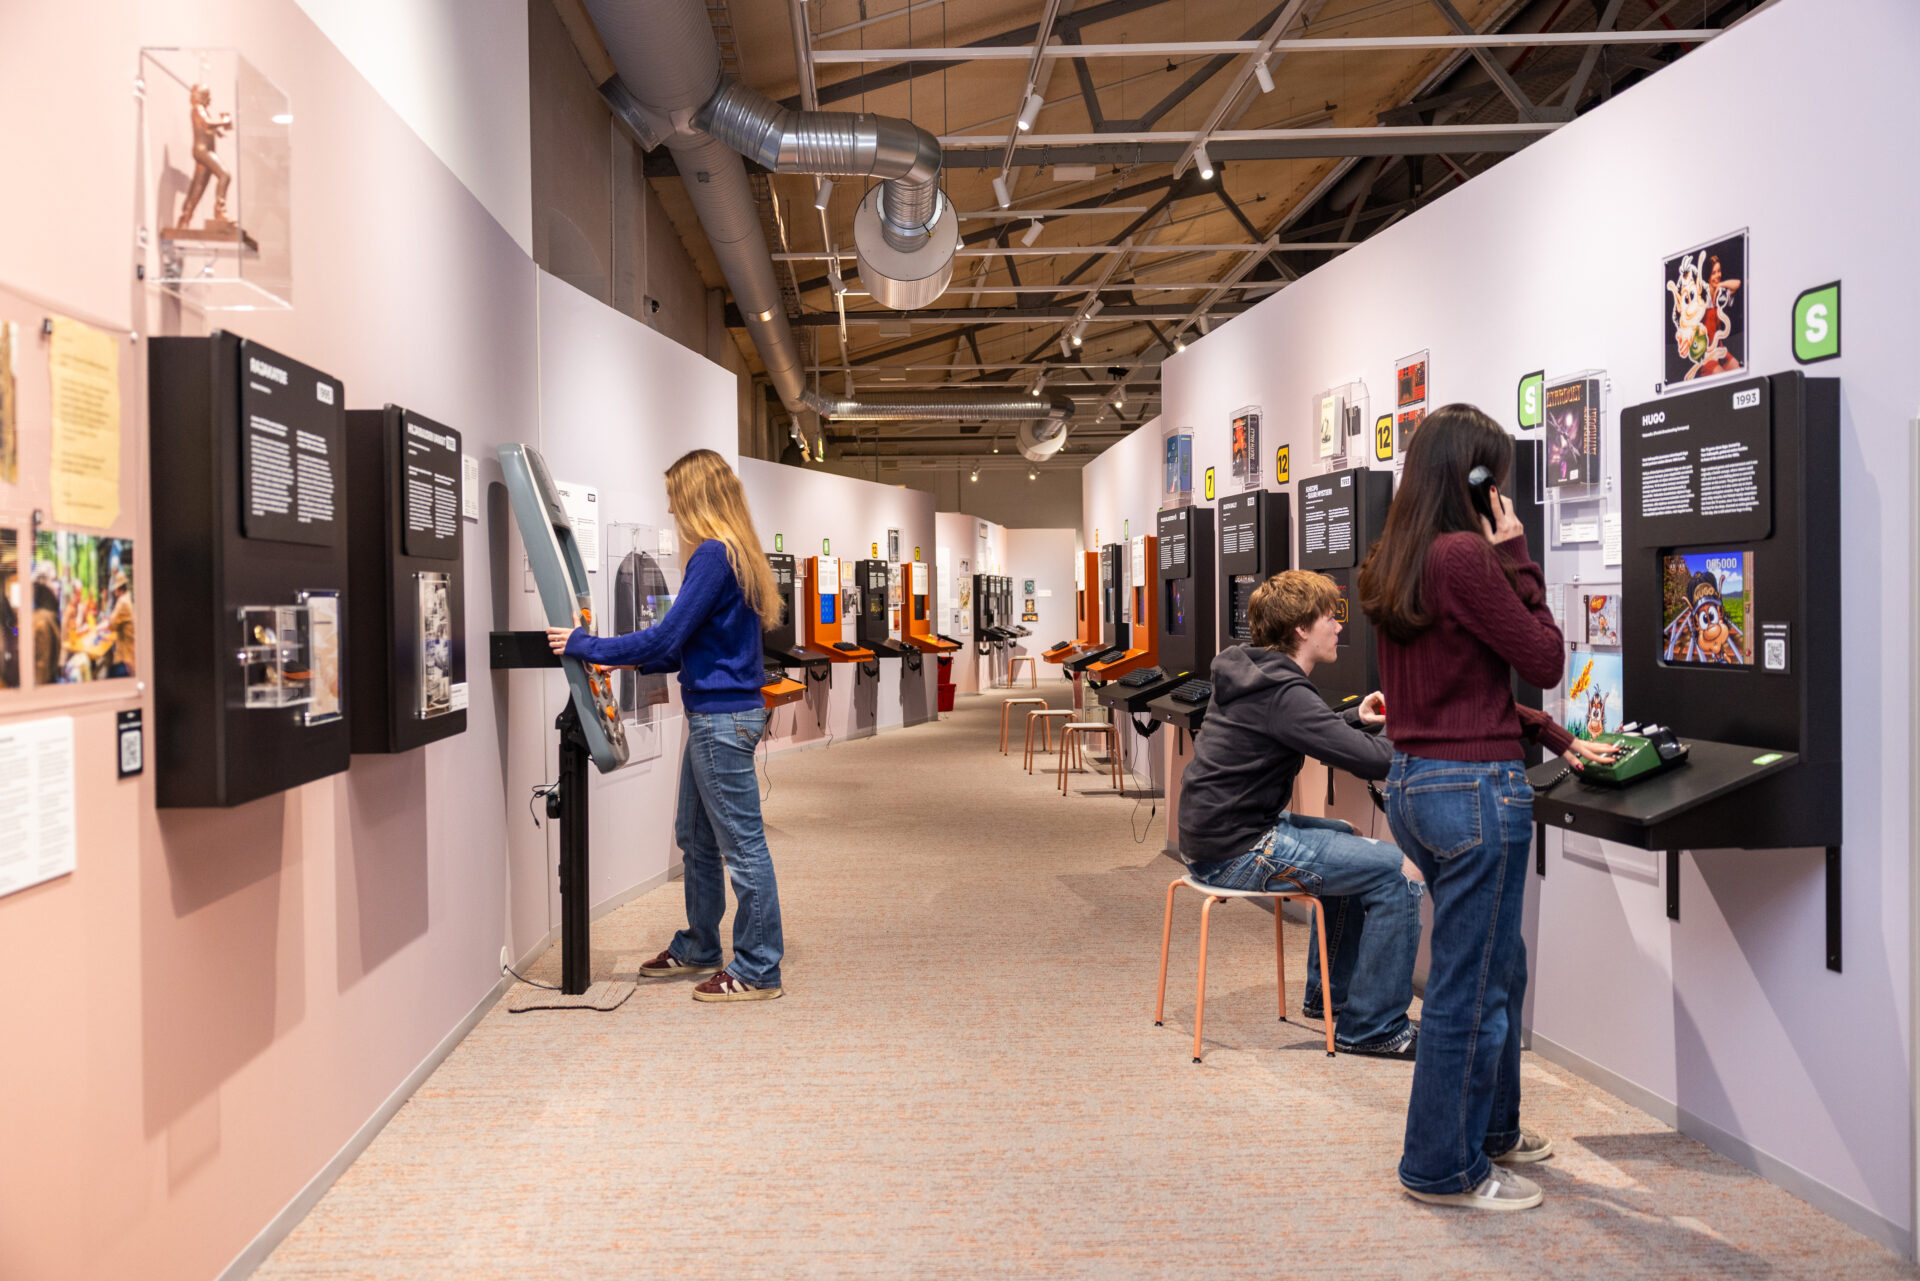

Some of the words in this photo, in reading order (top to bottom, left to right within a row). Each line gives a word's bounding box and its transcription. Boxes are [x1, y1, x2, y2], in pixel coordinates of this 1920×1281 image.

[1805, 303, 1828, 343] S
[1525, 386, 1536, 415] S
[1546, 384, 1581, 408] STARDUST
[1737, 393, 1757, 405] 1993
[1642, 411, 1665, 427] HUGO
[1378, 425, 1391, 449] 12
[1278, 454, 1288, 475] 12
[1207, 475, 1213, 492] 7
